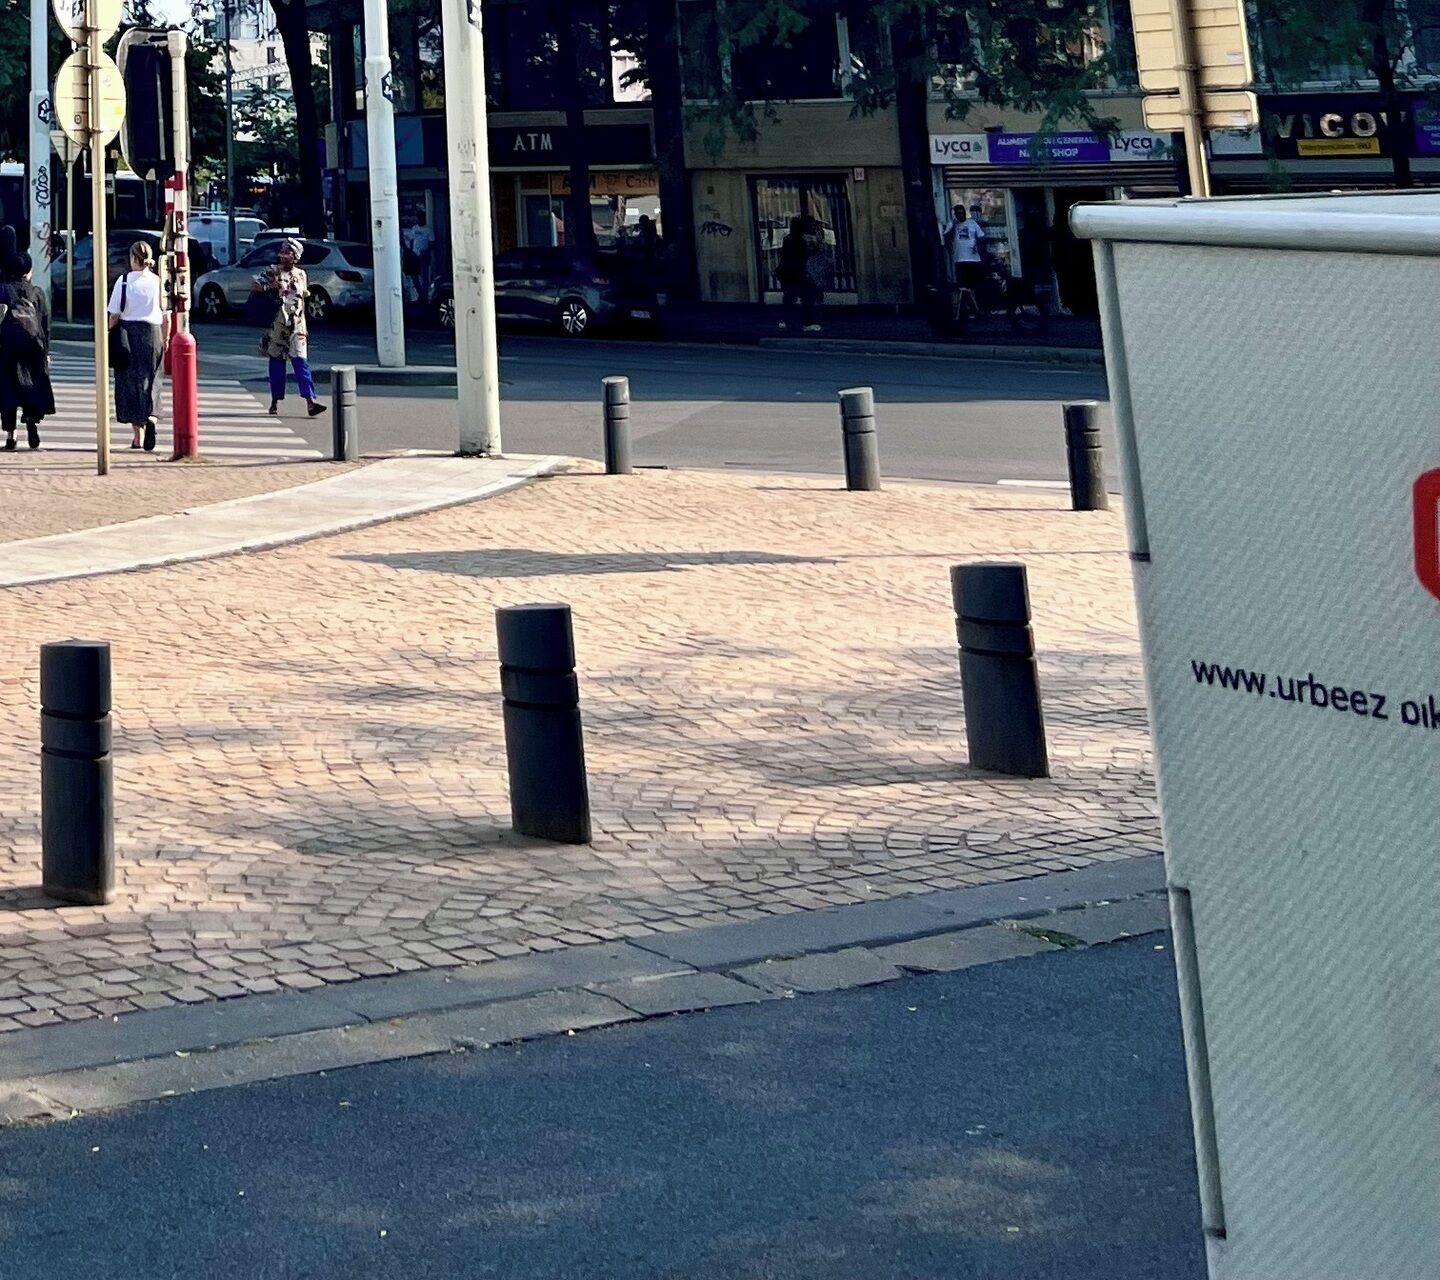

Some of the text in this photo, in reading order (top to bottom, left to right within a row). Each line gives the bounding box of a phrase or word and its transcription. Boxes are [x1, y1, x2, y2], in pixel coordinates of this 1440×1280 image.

[513, 133, 553, 151] ATM
[935, 139, 971, 156] Lyca
[1115, 137, 1152, 151] Lyca
[1051, 148, 1079, 157] SHOP
[1191, 659, 1389, 720] www.urbeez
